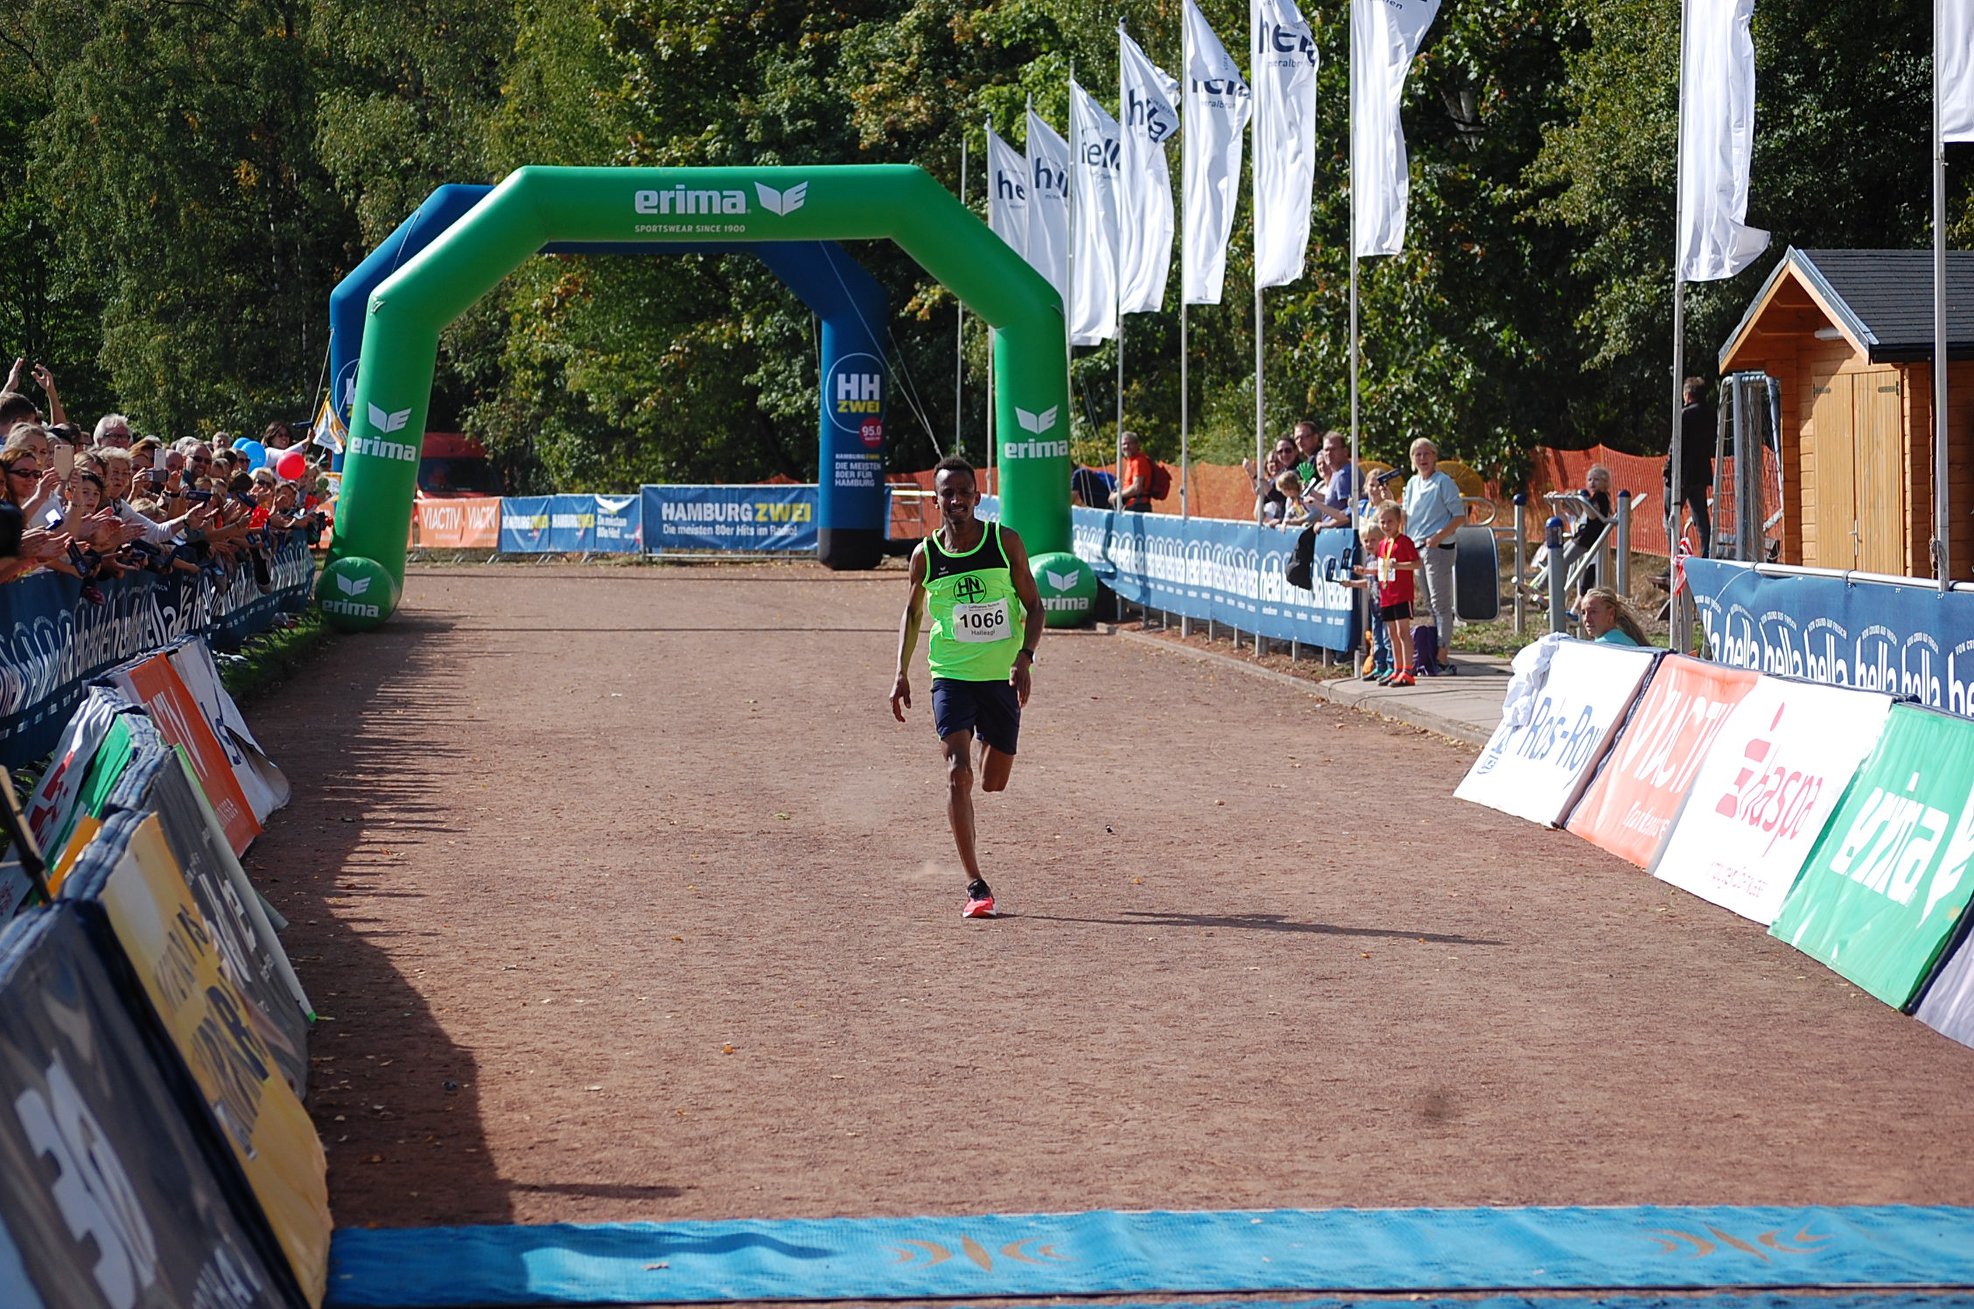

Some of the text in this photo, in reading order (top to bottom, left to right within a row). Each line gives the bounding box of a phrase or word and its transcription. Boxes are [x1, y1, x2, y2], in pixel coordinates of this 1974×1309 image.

[634, 184, 746, 214] erima
[634, 224, 746, 233] SPORTSWEAR SINCE 1900
[837, 373, 880, 400] HH
[837, 401, 880, 413] ZWEI
[350, 436, 416, 462] erima
[1004, 438, 1069, 459] erima
[835, 462, 881, 470] DIE MEISTEN
[857, 470, 873, 478] FÜR
[835, 479, 875, 487] HAMBURG
[421, 507, 461, 530] VIACTIV
[662, 503, 811, 522] HAMBURG ZWEI
[662, 524, 676, 535] Die
[678, 524, 713, 535] meisten
[715, 524, 734, 535] 80er
[736, 525, 755, 536] Hits
[757, 525, 768, 535] im
[322, 599, 380, 618] erima
[960, 609, 1004, 628] 1066
[1723, 612, 1759, 671] hella
[1759, 621, 1804, 678] hella
[1803, 628, 1849, 687] hella
[1855, 635, 1897, 693] hella
[1901, 644, 1941, 707] hella
[1829, 771, 1949, 907] erima
